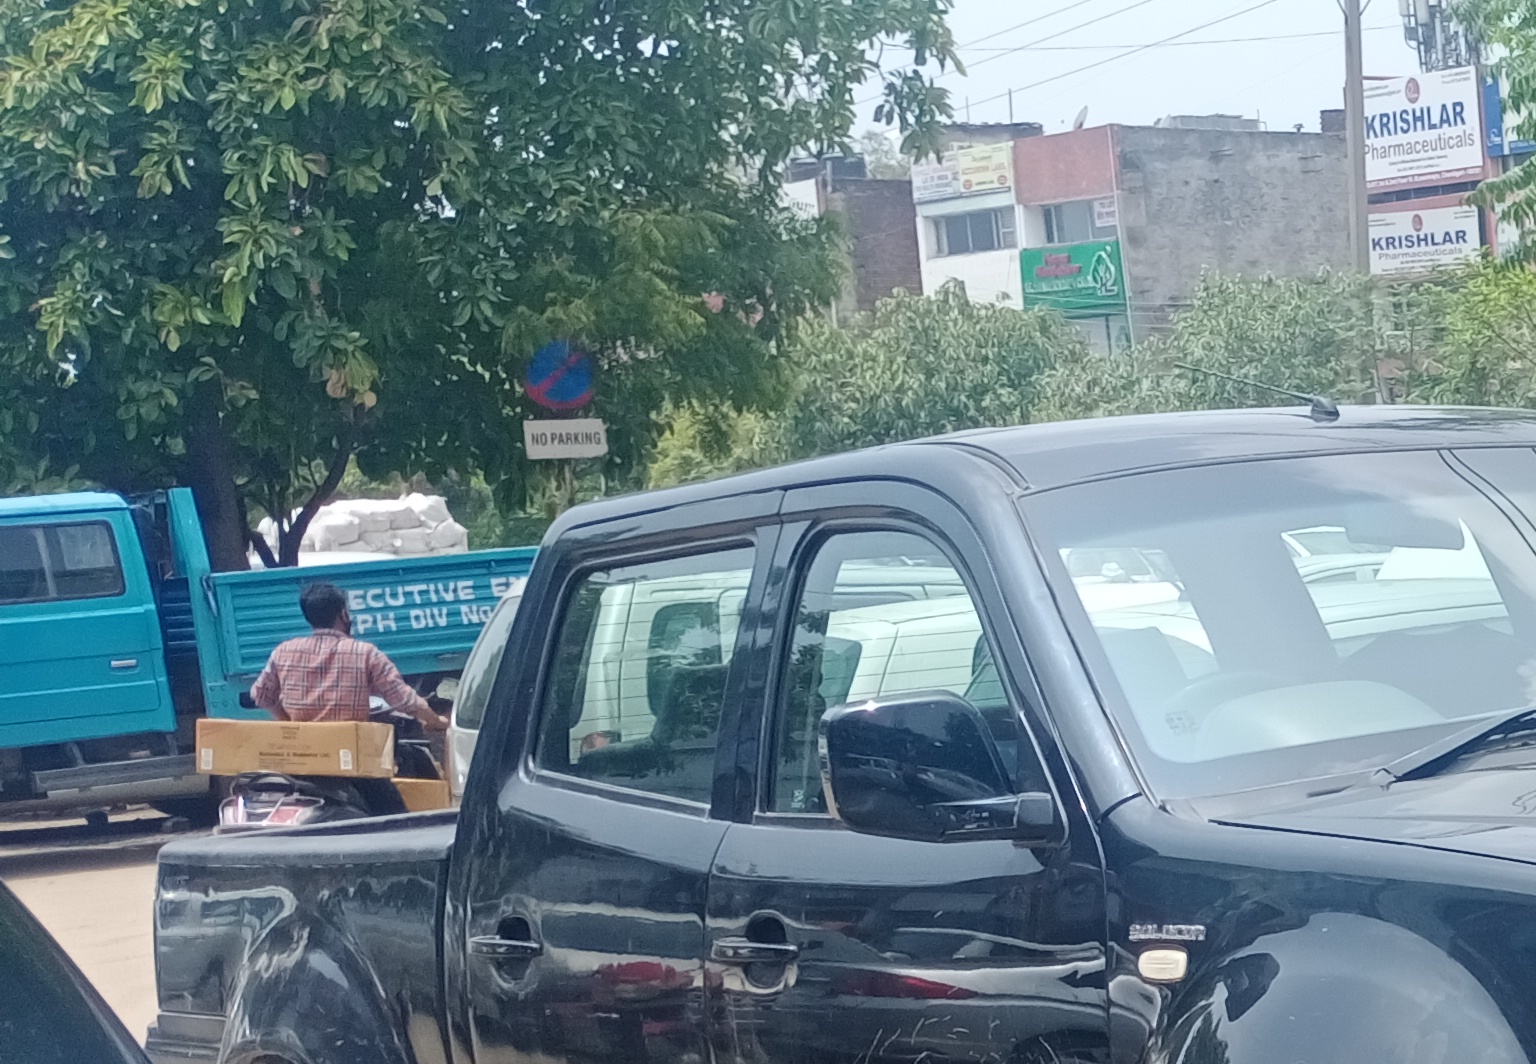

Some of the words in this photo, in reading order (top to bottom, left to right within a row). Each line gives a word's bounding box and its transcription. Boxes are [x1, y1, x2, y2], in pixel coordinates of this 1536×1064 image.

[1364, 101, 1466, 140] KRISHLAR
[1364, 130, 1475, 161] Pharmaceuticals
[1372, 230, 1468, 251] KRISHLAR
[1378, 246, 1463, 261] Pharmaceuticals
[531, 432, 548, 446] NO
[550, 431, 602, 445] PARKING
[347, 580, 475, 610] ECUTIVE
[351, 612, 397, 635] PH
[410, 606, 448, 629] DIV
